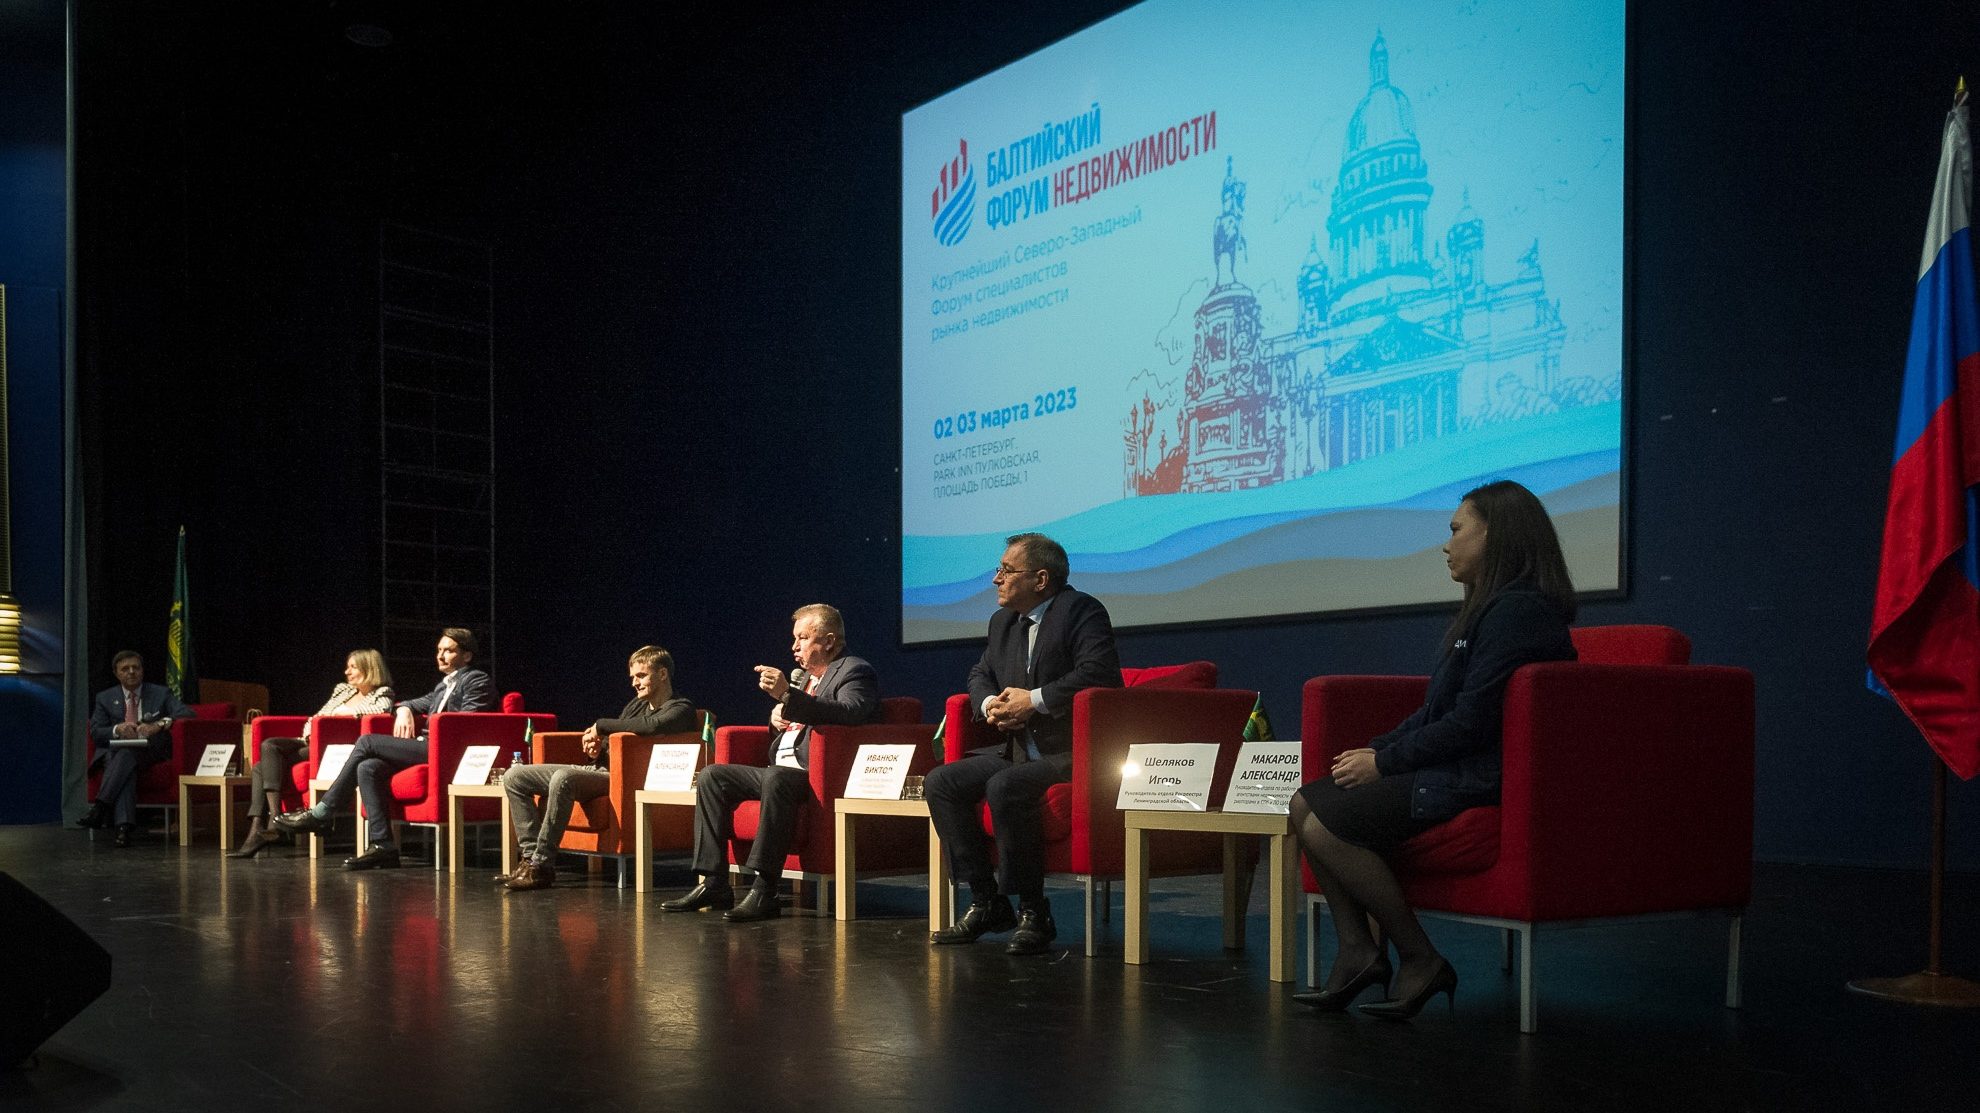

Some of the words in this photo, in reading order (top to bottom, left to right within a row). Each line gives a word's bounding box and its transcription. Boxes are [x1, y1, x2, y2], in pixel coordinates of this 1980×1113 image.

[986, 102, 1101, 189] БАЛТИЙСКИЙ
[986, 175, 1049, 231] ФОРУМ
[1053, 110, 1217, 208] НЕДВИЖИМОСТИ
[931, 250, 1011, 292] Крупнейший
[1014, 204, 1142, 265] Северо-Западный
[931, 291, 973, 316] Форум
[975, 260, 1068, 303] специалистов
[931, 319, 969, 344] рынка
[972, 287, 1069, 326] недвижимости
[934, 416, 953, 440] 02
[957, 410, 976, 433] 03
[981, 402, 1029, 430] марта
[1034, 386, 1078, 418] 2023
[933, 466, 956, 482] PARK
[957, 463, 974, 477] INN
[933, 479, 979, 498] ПЛОЩАДЬ
[1024, 470, 1028, 483] 1
[866, 754, 900, 762] ИВАНЮК
[1144, 757, 1195, 767] Шеляков
[1240, 770, 1300, 782] АЛЕКСАНДР
[1250, 754, 1299, 765] МАКАРОВ
